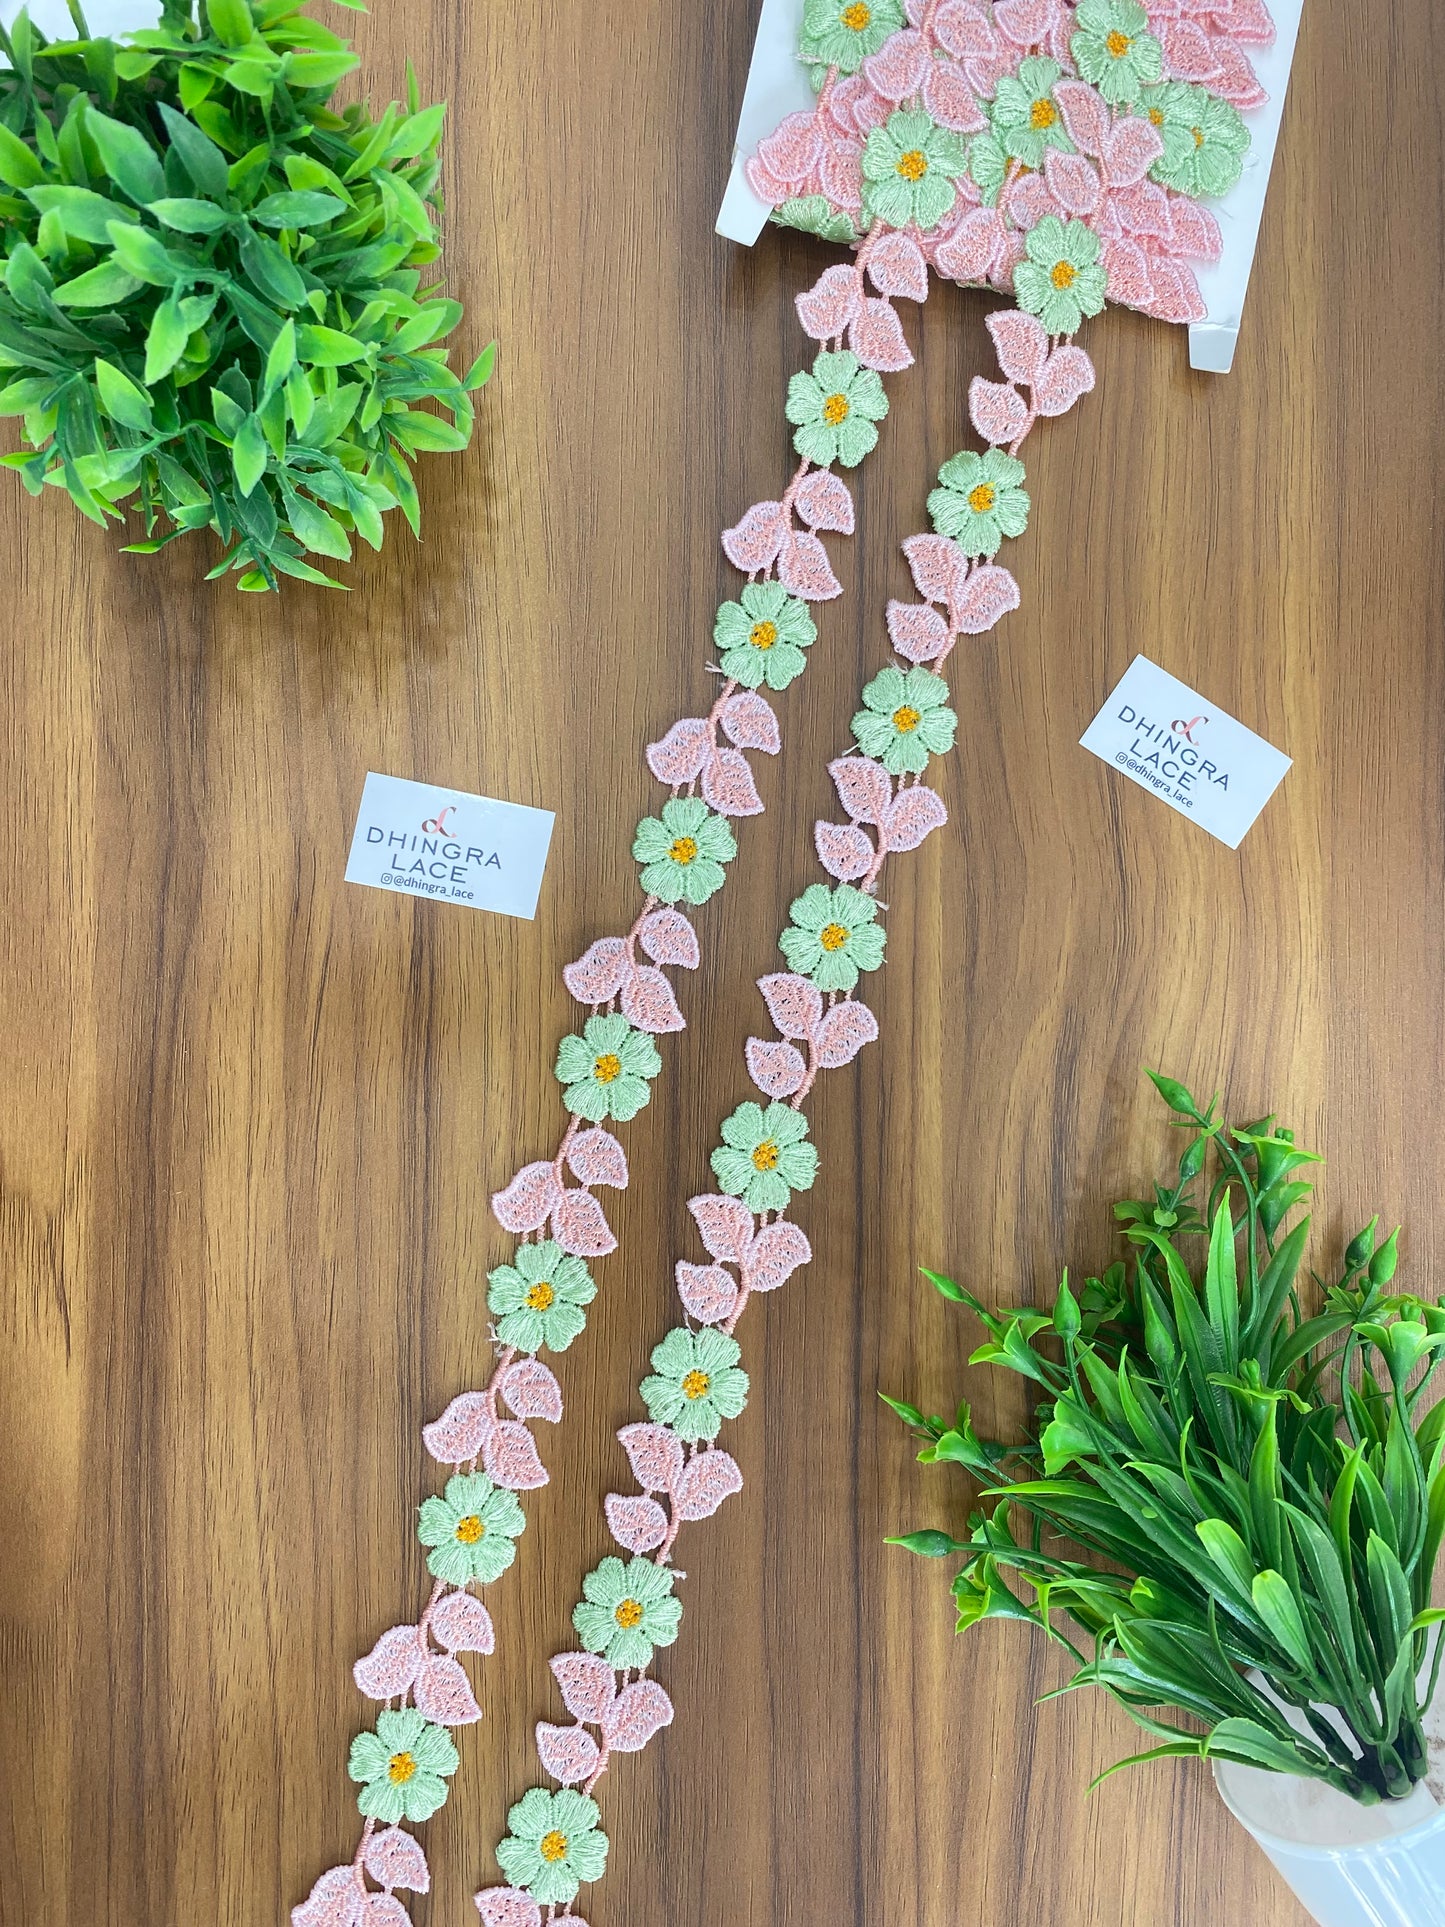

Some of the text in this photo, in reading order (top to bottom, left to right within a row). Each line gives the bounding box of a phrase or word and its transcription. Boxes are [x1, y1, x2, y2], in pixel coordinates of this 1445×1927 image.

[1117, 705, 1230, 791] DHINGRA
[1129, 738, 1197, 791] LACE
[1126, 759, 1193, 808] @dhingra_lace
[366, 826, 502, 870] DHINGRA
[391, 853, 469, 884] LACE
[393, 874, 475, 900] @dhingra_lace
